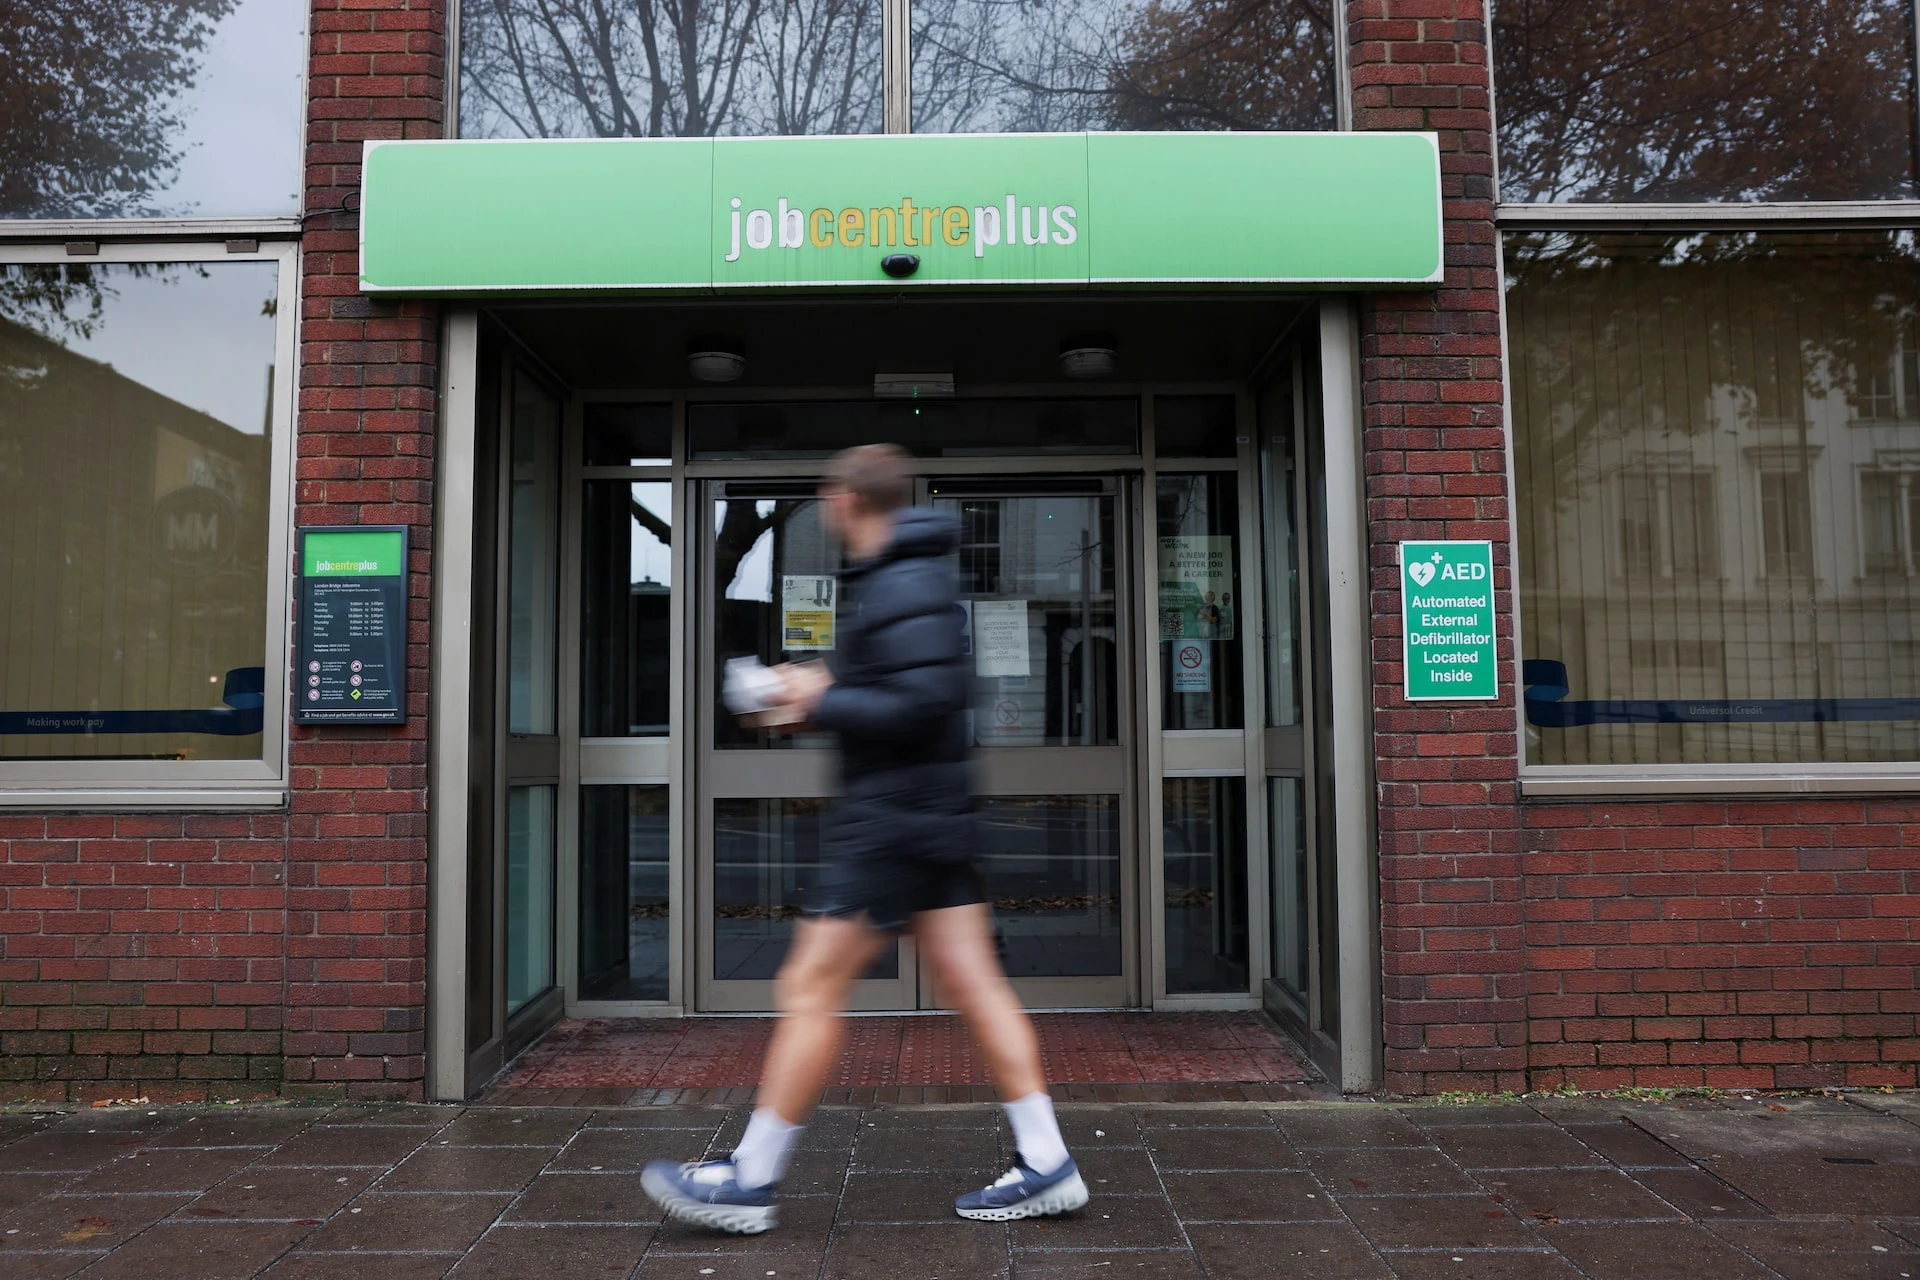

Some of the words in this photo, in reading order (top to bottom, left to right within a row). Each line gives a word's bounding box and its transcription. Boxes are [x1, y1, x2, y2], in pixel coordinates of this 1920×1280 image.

[724, 194, 1078, 262] jobcentreplus
[316, 560, 378, 573] jobcentreplus
[1441, 563, 1486, 581] AED
[1412, 595, 1487, 608] Automated
[1422, 614, 1478, 627] External
[1410, 632, 1491, 645] Defibrillator
[1423, 651, 1479, 663] Located
[1430, 669, 1473, 682] Inside
[1689, 705, 1734, 716] Universal
[1735, 705, 1764, 716] Credit
[27, 717, 61, 729] Making
[63, 717, 86, 727] work
[87, 718, 105, 729] pay
